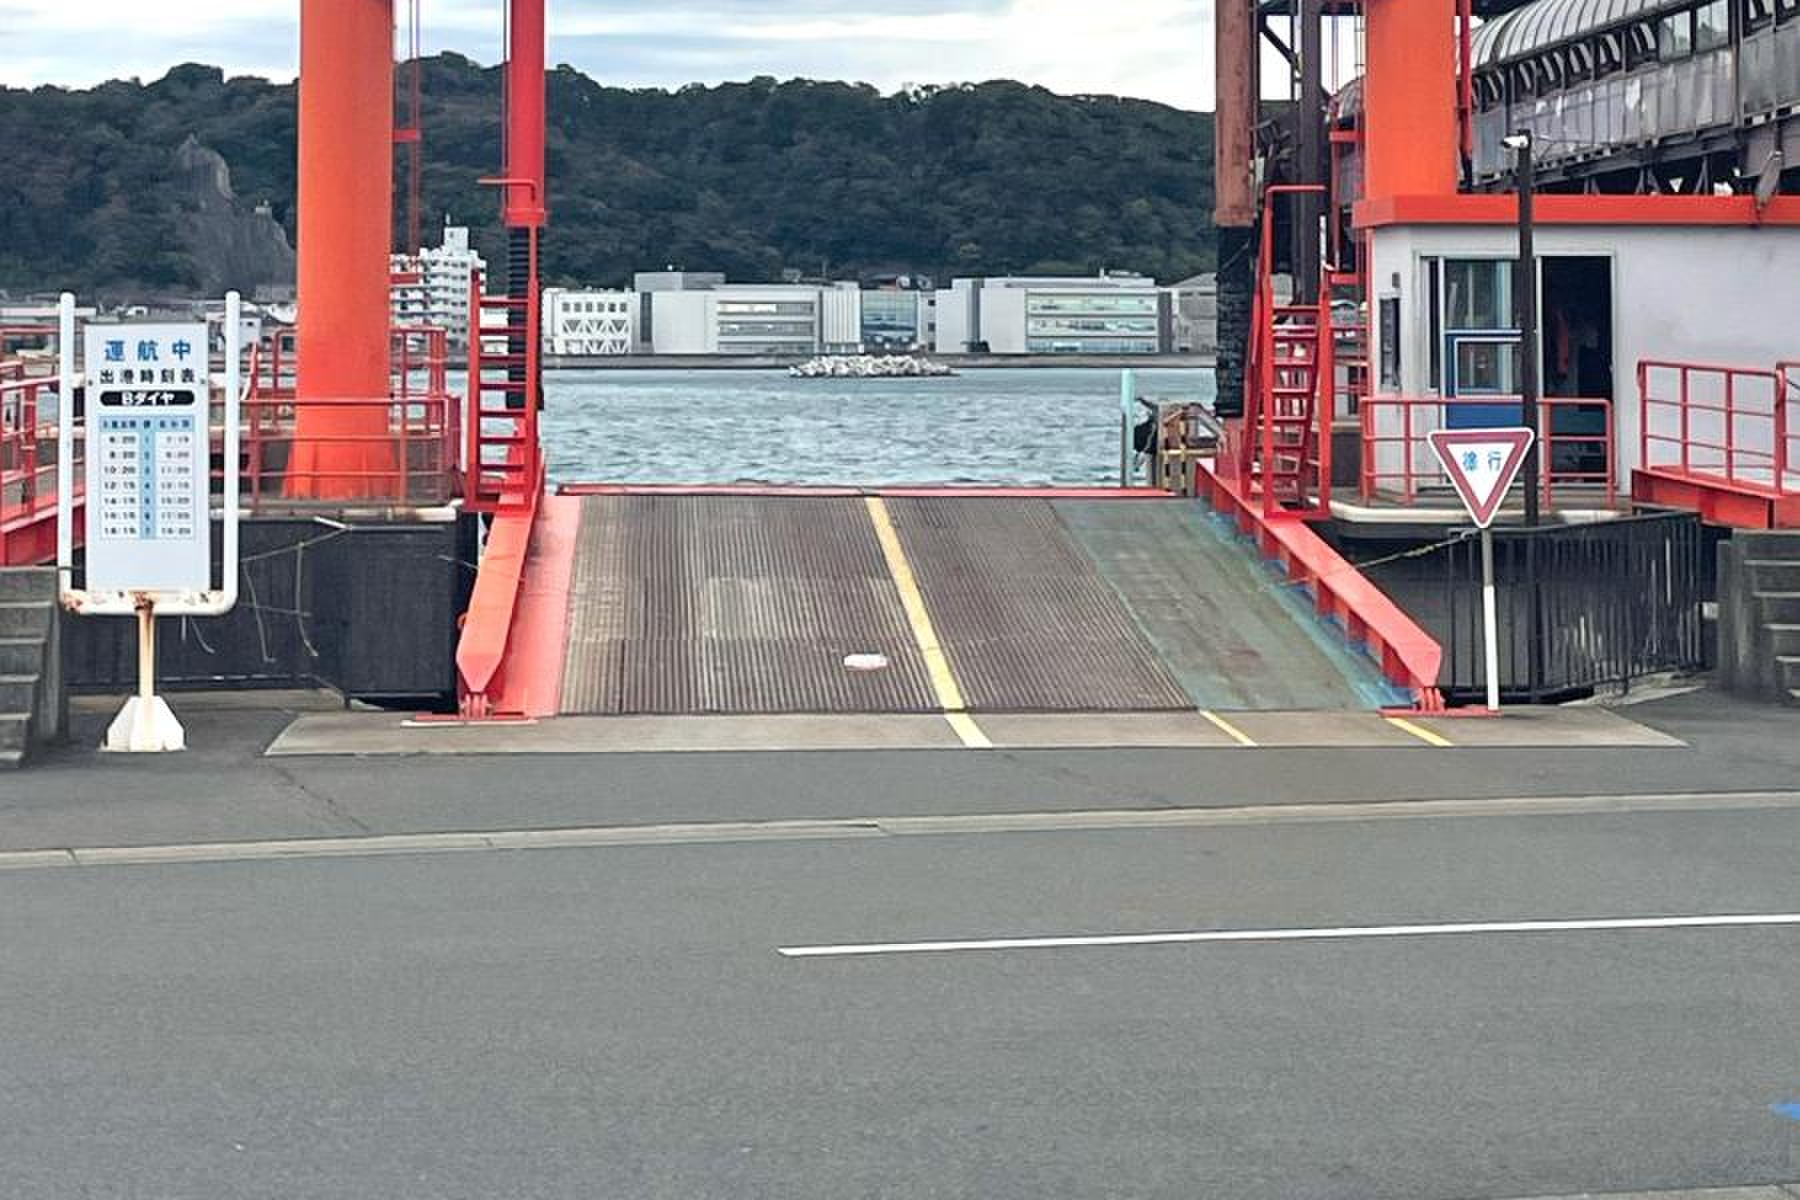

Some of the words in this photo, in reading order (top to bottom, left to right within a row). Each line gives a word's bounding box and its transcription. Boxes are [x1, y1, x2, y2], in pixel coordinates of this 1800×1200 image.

[104, 339, 191, 361] 運航中
[100, 368, 195, 384] 出港時刻表
[1462, 450, 1502, 472] 徐行
